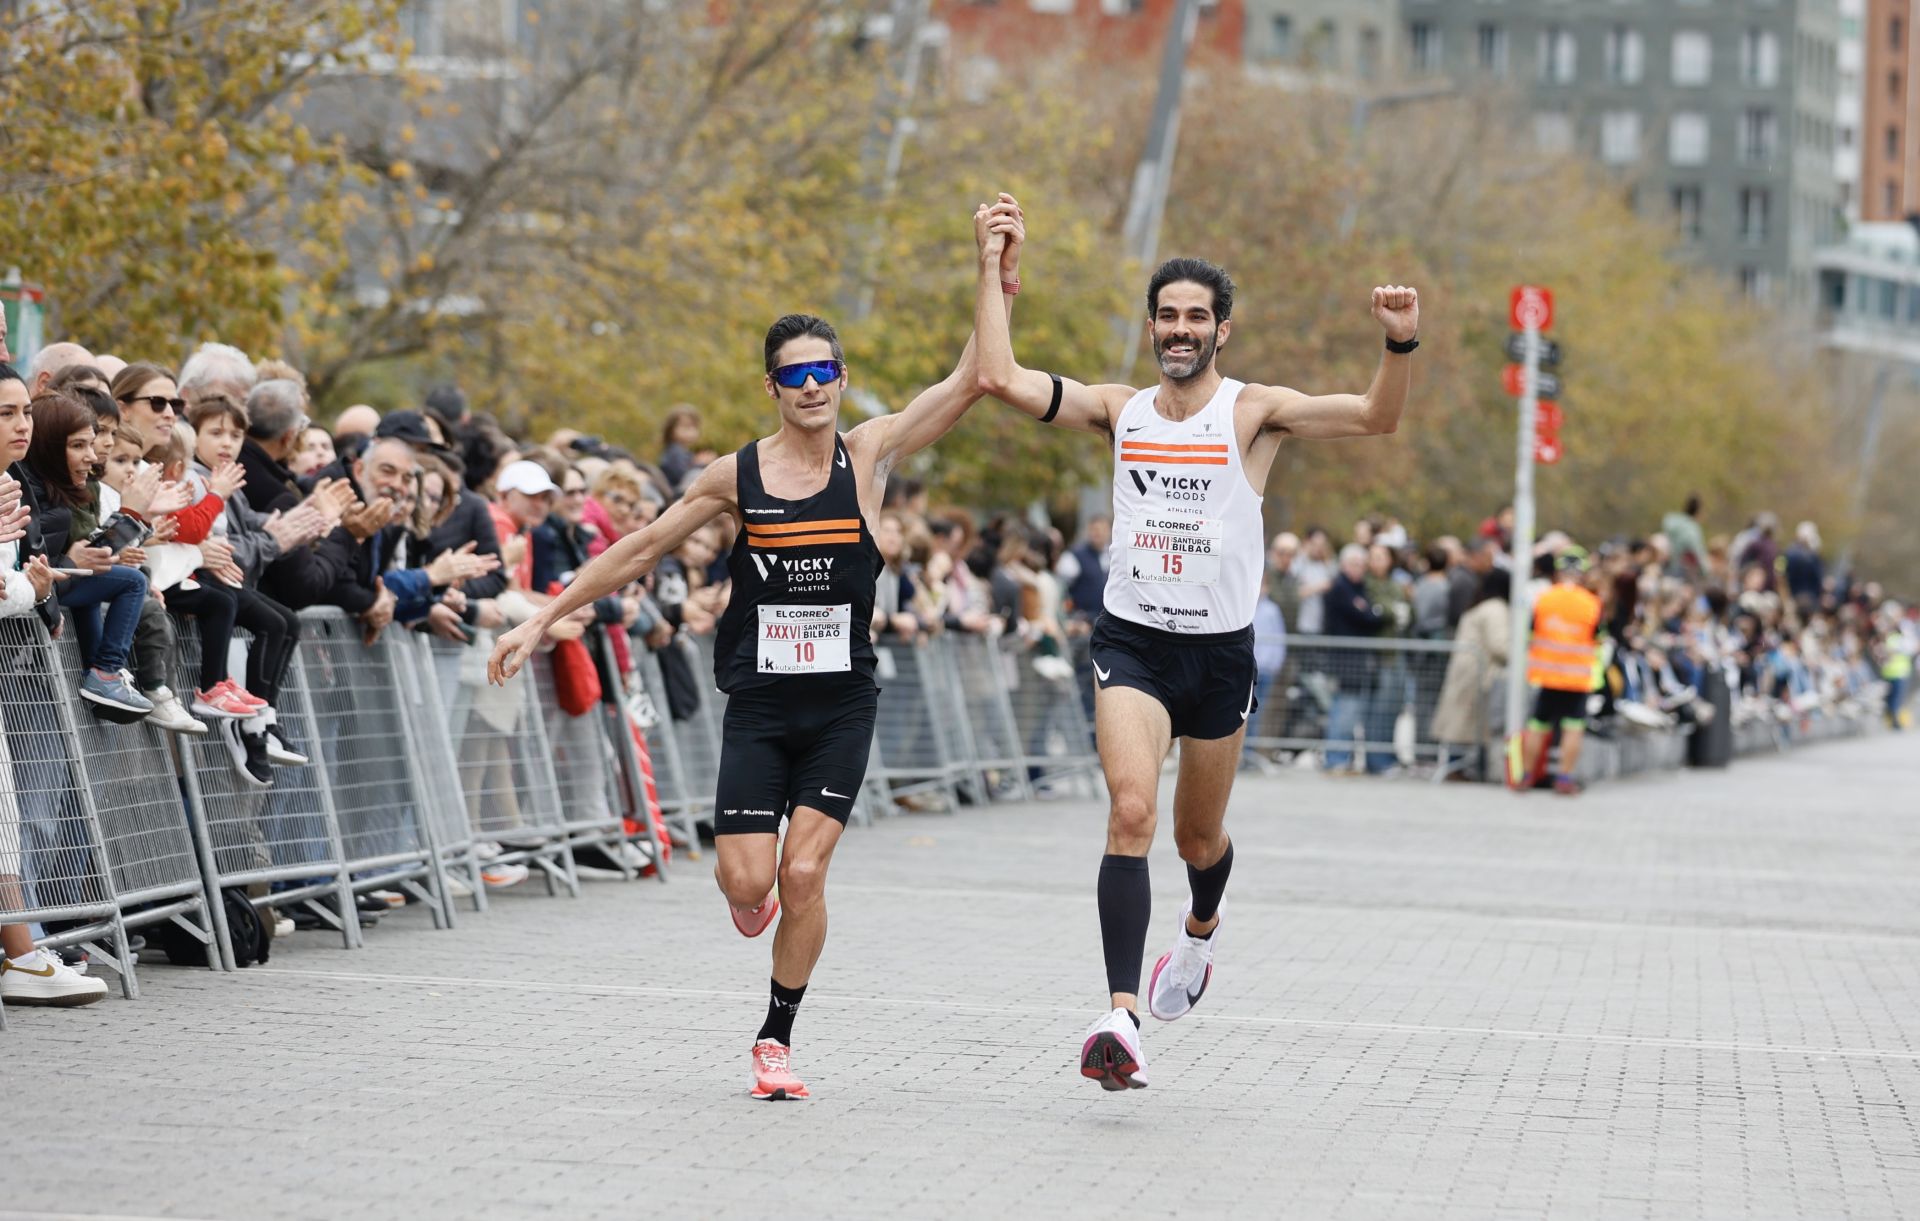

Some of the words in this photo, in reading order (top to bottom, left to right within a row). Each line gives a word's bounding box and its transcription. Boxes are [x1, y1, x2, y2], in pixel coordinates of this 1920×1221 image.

[1161, 476, 1212, 491] VICKY
[1166, 491, 1206, 502] FOODS
[1167, 507, 1203, 515] ATHLETICS
[1146, 519, 1157, 528] EL
[1158, 520, 1200, 531] CORREO
[1133, 532, 1170, 550] XXXVI
[1172, 536, 1211, 546] SANTURCE
[1172, 543, 1211, 554] BILBAO
[782, 557, 834, 572] VICKY
[1161, 553, 1183, 575] 15
[788, 571, 830, 583] FOODS
[1141, 573, 1182, 583] kutxabank
[788, 584, 830, 592] ATHLETICS
[776, 610, 787, 618] EL
[788, 610, 830, 619] CORREO
[1138, 603, 1157, 612] TOP
[1163, 606, 1209, 617] RUNNING
[766, 624, 801, 639] XXXVI
[803, 623, 841, 631] SANTURCE
[803, 630, 840, 639] BILBAO
[794, 641, 815, 663] 10
[775, 663, 816, 672] kutxabank
